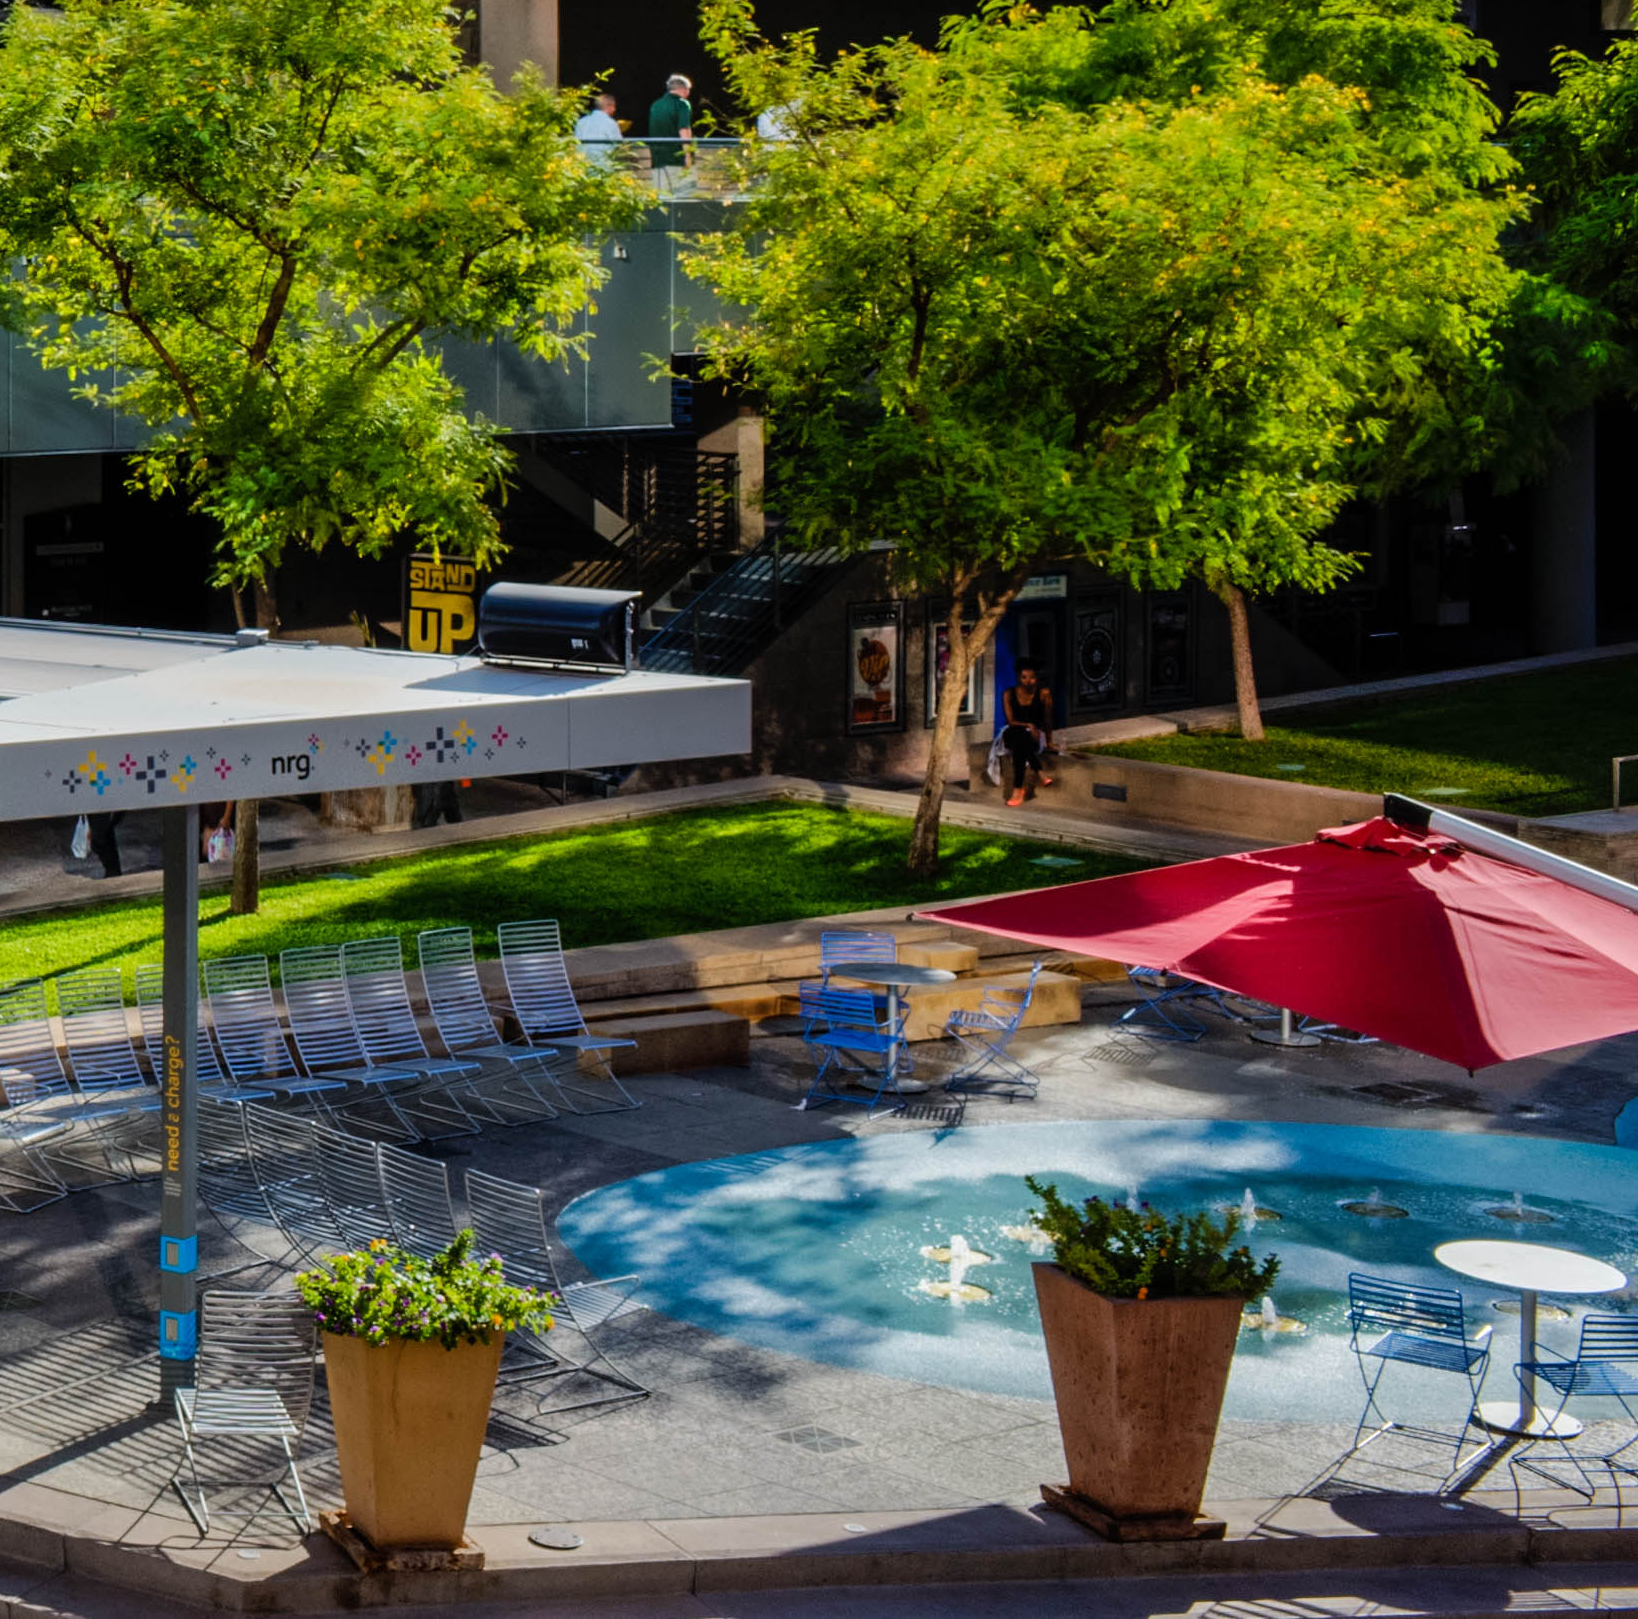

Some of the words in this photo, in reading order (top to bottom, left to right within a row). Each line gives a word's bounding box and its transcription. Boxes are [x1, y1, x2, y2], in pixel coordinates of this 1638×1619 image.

[409, 559, 475, 593] STAND
[408, 589, 475, 654] UP
[271, 750, 311, 780] nrg
[165, 1035, 184, 1109] charge?
[166, 1125, 180, 1172] need
